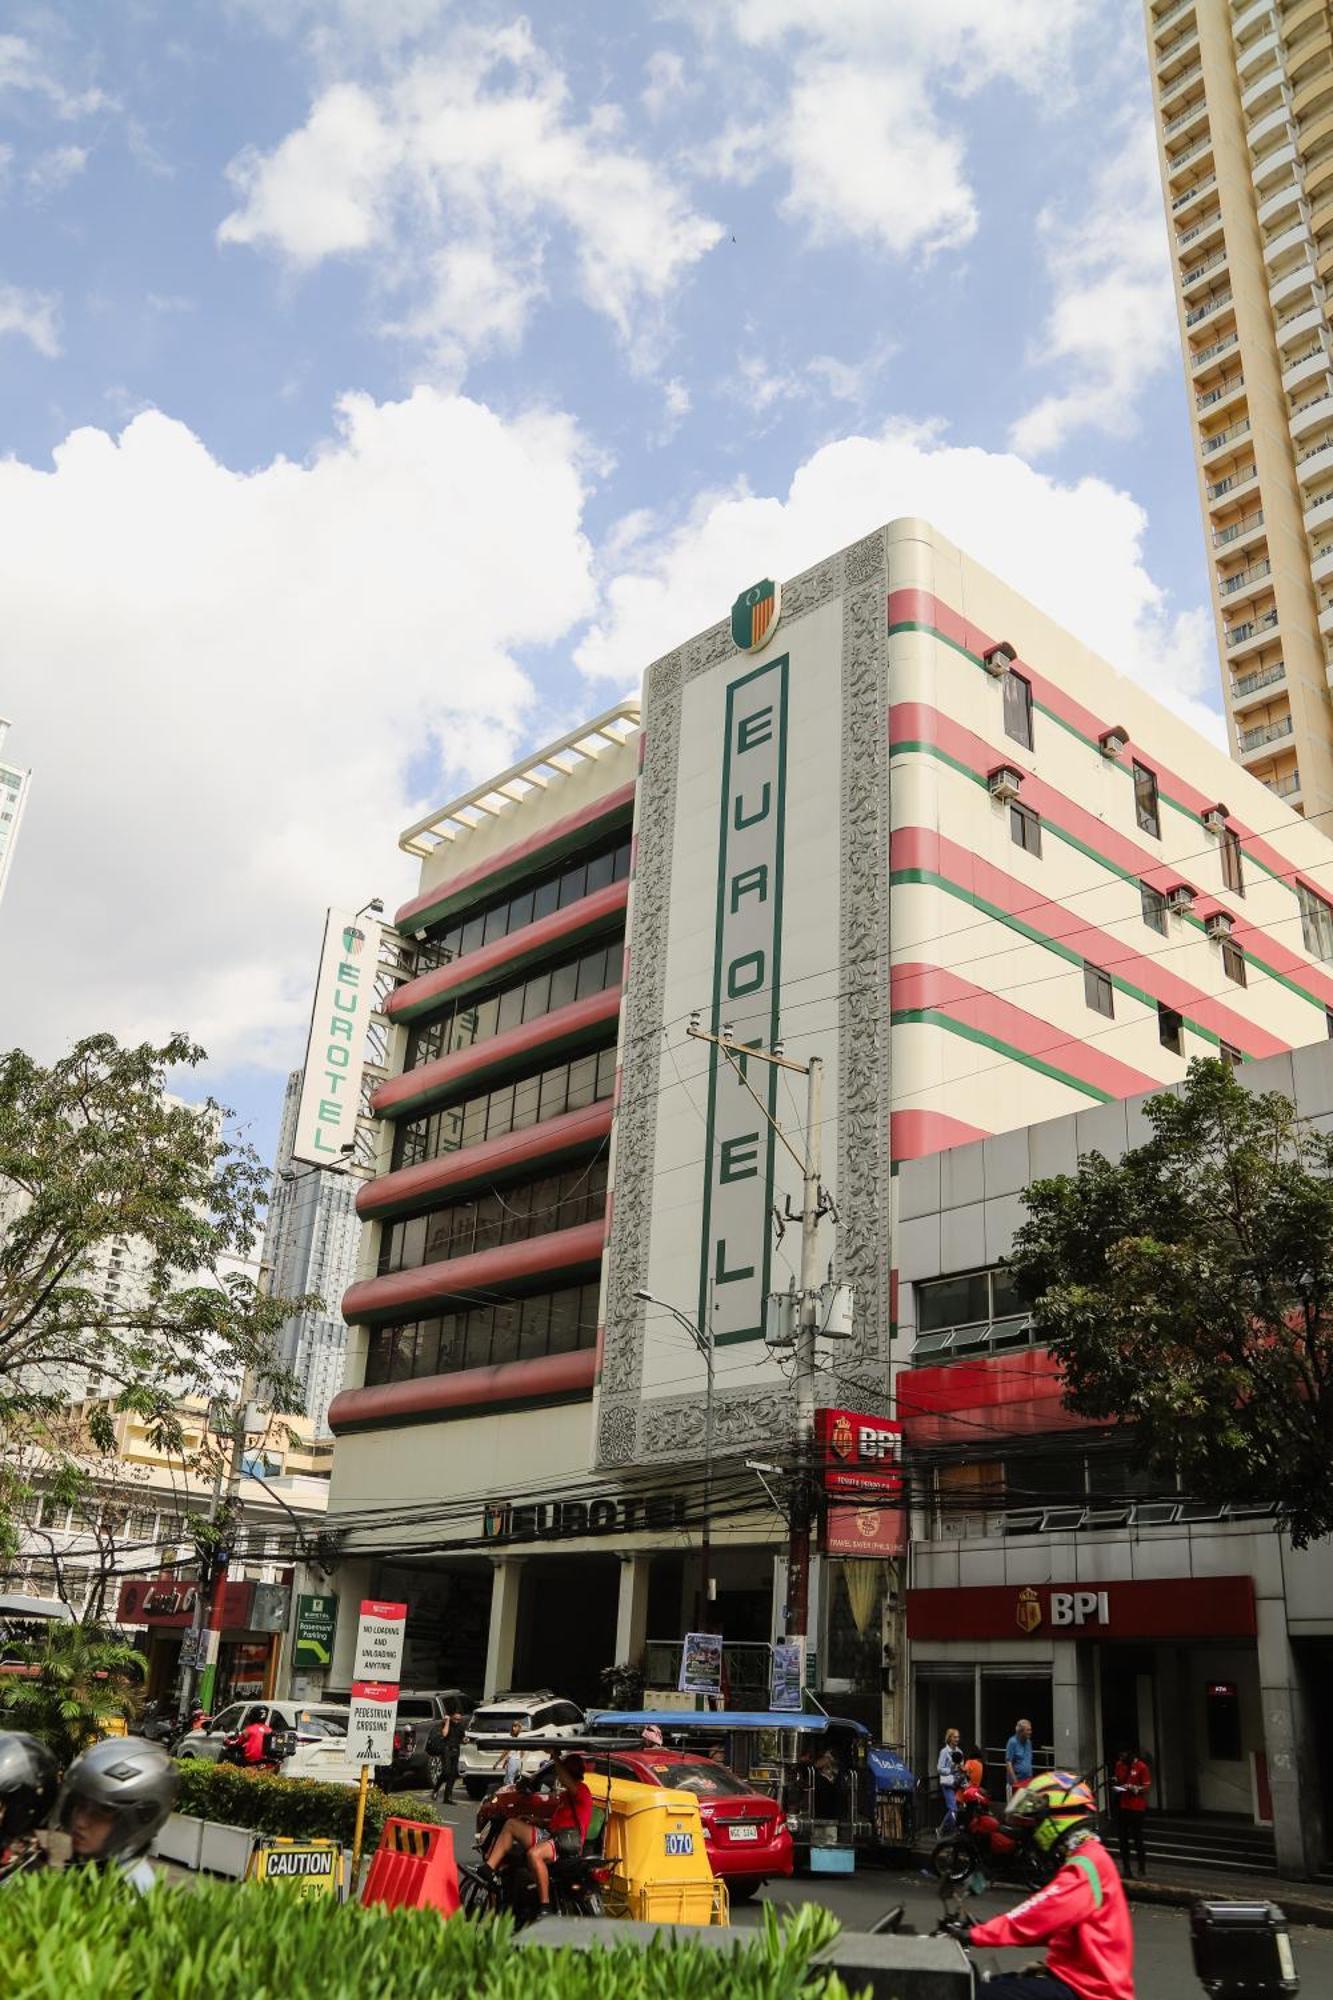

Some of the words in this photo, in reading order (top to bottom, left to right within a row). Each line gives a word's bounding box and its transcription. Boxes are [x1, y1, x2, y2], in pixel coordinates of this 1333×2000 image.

[715, 705, 774, 1285] EUROTEL
[313, 961, 361, 1154] EUROTEL
[858, 1426, 902, 1461] BPI
[1050, 1591, 1110, 1625] BPI
[299, 1622, 333, 1632] Basement
[363, 1626, 373, 1635] NO
[373, 1627, 400, 1636] LOADING
[302, 1631, 328, 1641] Parking
[373, 1638, 388, 1647] AND
[362, 1649, 397, 1659] UNLOADING
[364, 1661, 392, 1670] ANYTIME
[354, 1707, 393, 1719] PEDESTRIAN
[356, 1720, 388, 1732] CROSSING
[668, 1834, 693, 1854] 070
[267, 1852, 332, 1876] CAUTION
